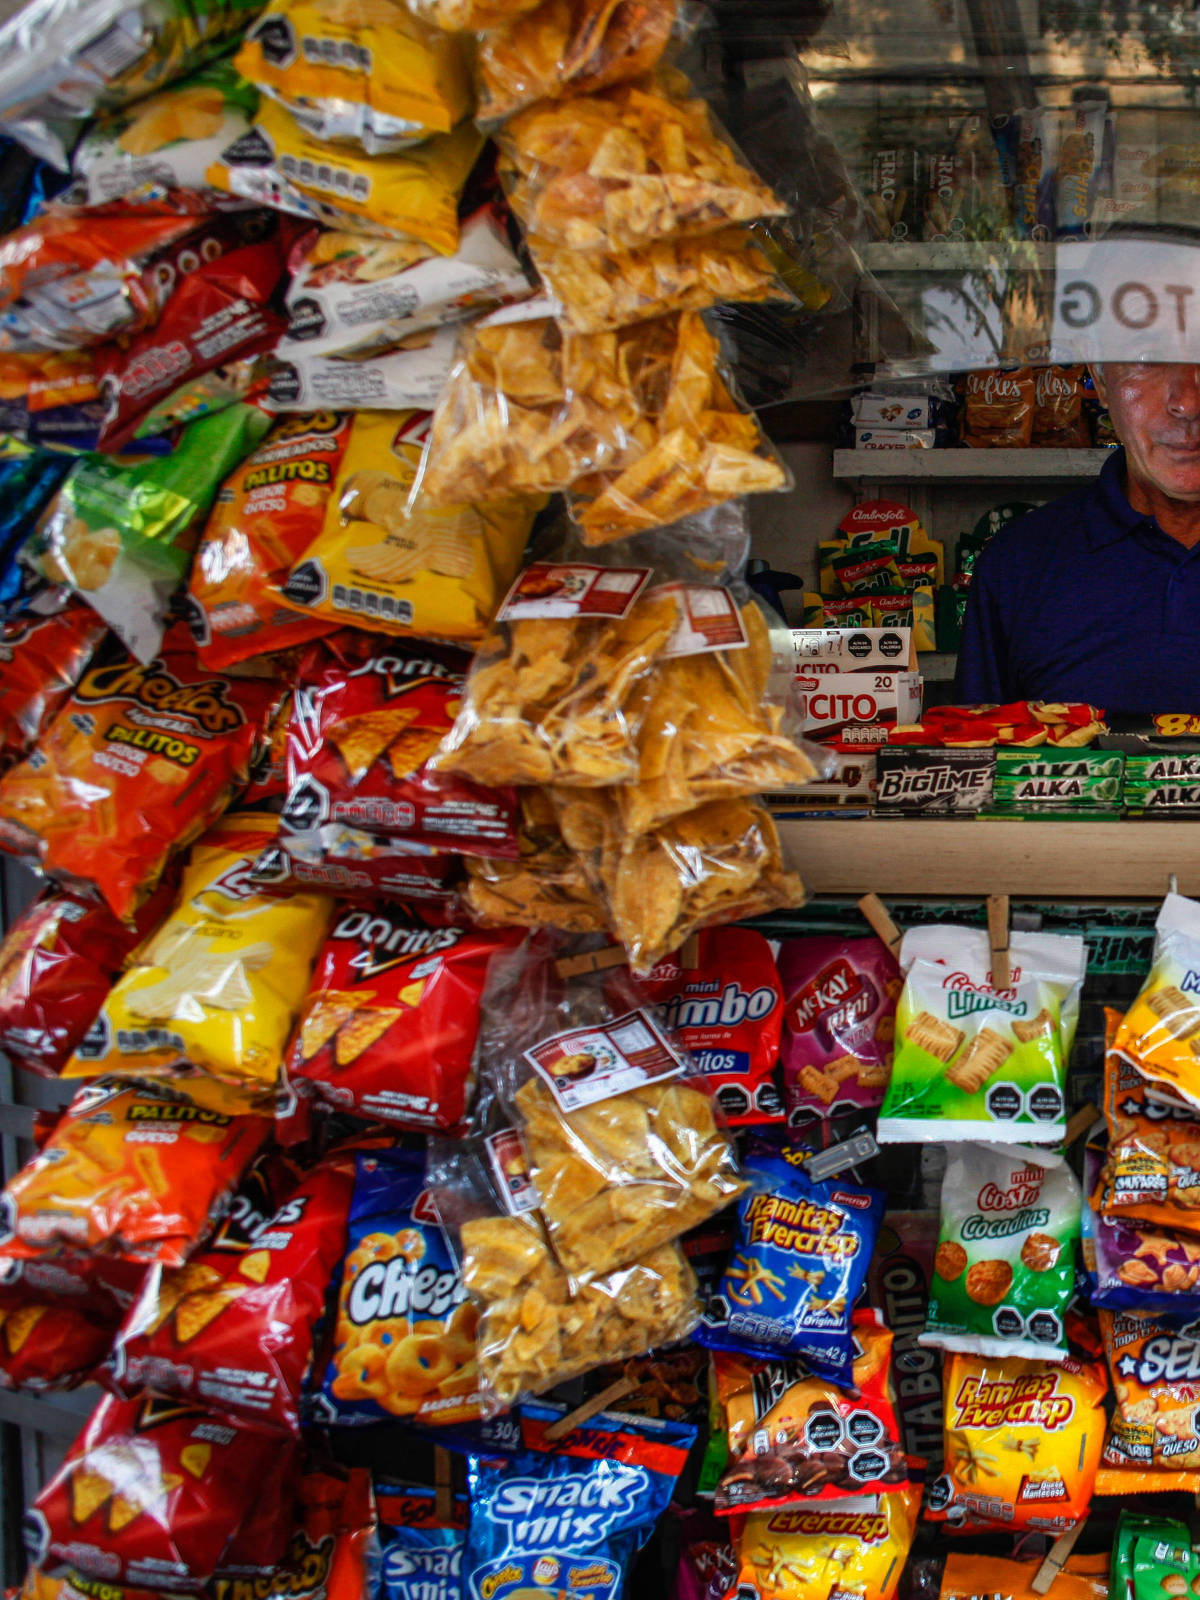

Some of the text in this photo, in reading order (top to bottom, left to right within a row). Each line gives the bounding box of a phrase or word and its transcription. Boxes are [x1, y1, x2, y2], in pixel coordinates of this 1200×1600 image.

[1073, 157, 1095, 219] CHIPS
[1035, 370, 1077, 408] fles
[244, 460, 331, 493] PALITOS
[852, 509, 905, 522] Ambrosoli
[874, 675, 893, 688] 20
[75, 661, 240, 734] Cheetos
[802, 693, 878, 721] CITO
[1154, 713, 1191, 736] 8
[106, 725, 199, 766] PALITOS
[1017, 779, 1082, 798] ALKA
[333, 911, 466, 953] Doritos
[686, 979, 720, 994] mini
[655, 981, 778, 1029] imbo
[128, 1105, 231, 1125] PALITOS
[125, 1130, 178, 1143] QUESO
[1010, 1167, 1045, 1186] mini
[976, 1182, 1041, 1212] Costa
[746, 1193, 844, 1233] Ramitas
[961, 1208, 1049, 1241] Cocaditas
[750, 1216, 859, 1261] Evercrisp
[804, 1313, 844, 1328] Original
[825, 1339, 840, 1361] 42
[1113, 1332, 1138, 1348] TODO
[958, 1374, 1055, 1405] Ramitas
[956, 1398, 1073, 1430] Evercrisp
[1162, 1438, 1199, 1457] QUESO
[494, 1474, 639, 1515] Snack
[1022, 1488, 1065, 1500] Mantecoso
[1041, 1480, 1064, 1491] Queso
[515, 1510, 597, 1544] mix
[767, 1510, 889, 1543] Evercrisp
